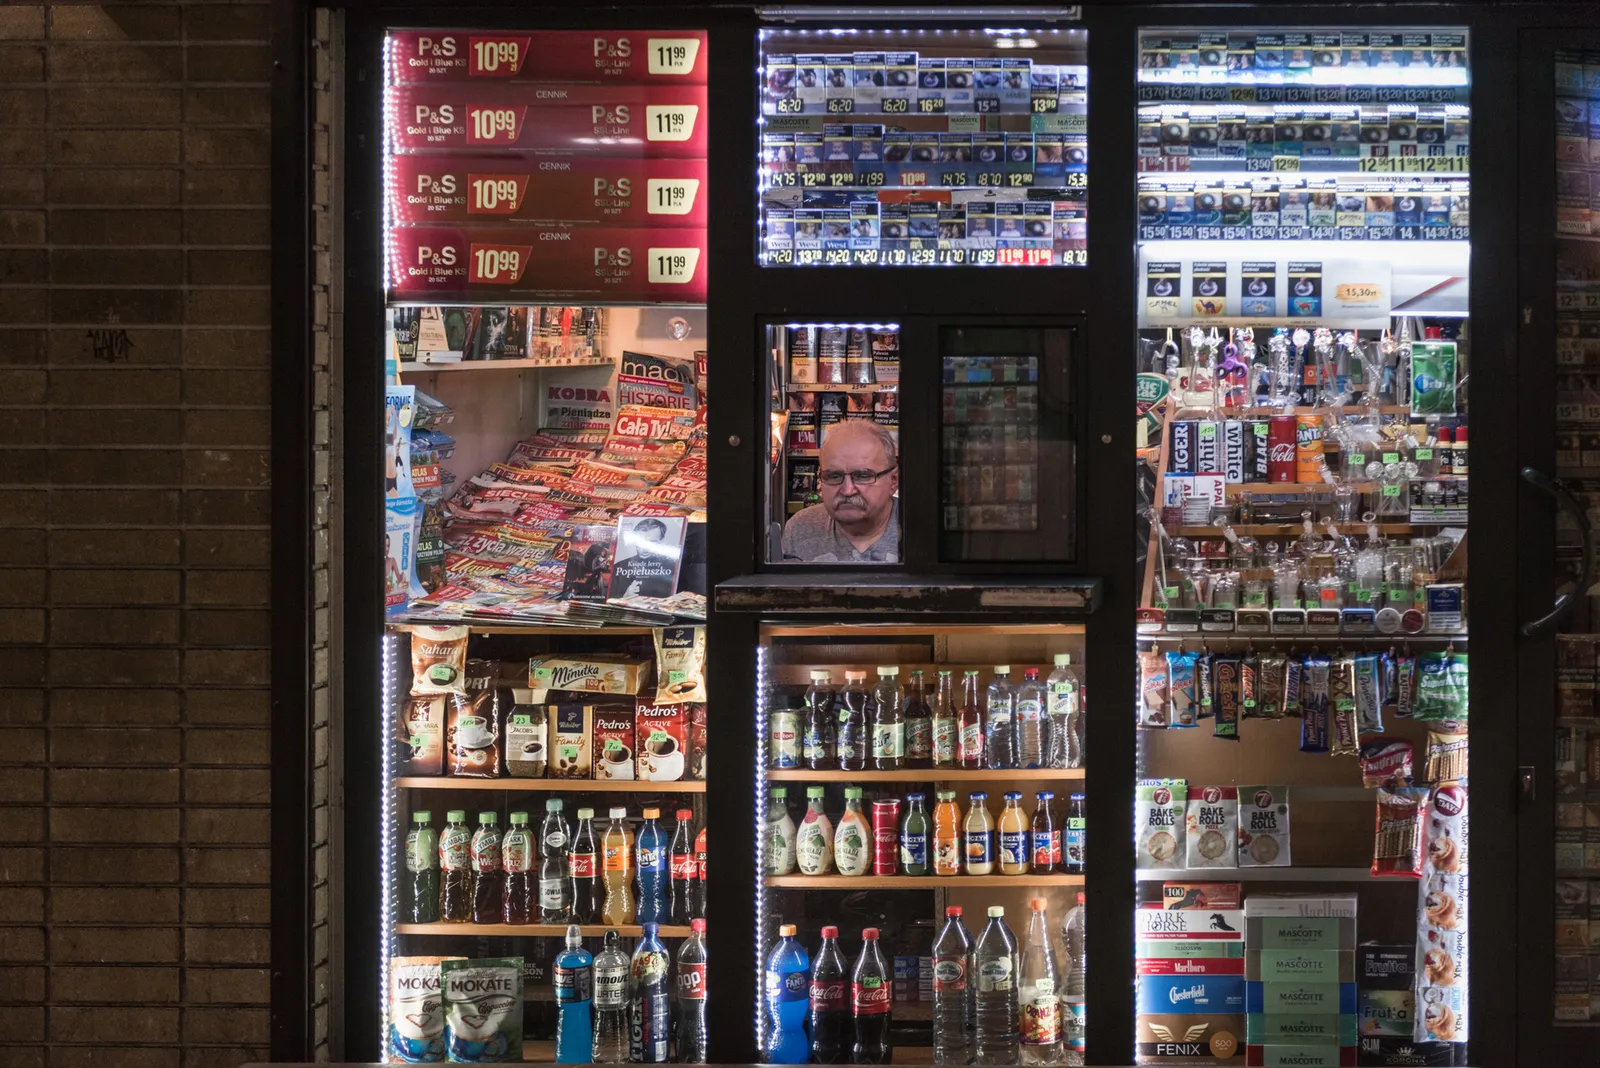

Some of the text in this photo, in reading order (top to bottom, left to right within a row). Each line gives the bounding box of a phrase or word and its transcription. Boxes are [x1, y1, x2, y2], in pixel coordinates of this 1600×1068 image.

[419, 37, 457, 56] P&S
[593, 38, 632, 57] P&S
[409, 58, 428, 67] Gold
[435, 58, 453, 66] Blue
[455, 58, 467, 66] KS
[536, 90, 568, 98] CENNIK
[416, 105, 454, 124] P&S
[592, 105, 631, 124] P&S
[407, 126, 427, 134] Gold
[433, 126, 452, 134] Blue
[539, 162, 571, 170] CENNIK
[417, 174, 456, 193] P&S
[593, 177, 632, 197] P&S
[407, 195, 427, 203] Gold
[434, 195, 453, 203] Blue
[454, 196, 466, 204] KS
[770, 241, 792, 249] West
[798, 241, 820, 249] West
[826, 240, 848, 249] West
[418, 246, 456, 265] P&S
[594, 247, 632, 266] P&S
[409, 267, 428, 275] Gold
[434, 267, 453, 275] Blue
[1140, 379, 1158, 389] tic
[548, 387, 610, 402] KOBRA
[1140, 388, 1157, 398] tac
[619, 391, 691, 409] HISTORIE
[561, 407, 611, 419] Pieniądze
[617, 417, 671, 440] Cała Ty!
[1297, 426, 1321, 443] FANTA
[519, 443, 590, 459] DETEKTYW
[1175, 424, 1188, 472] IGER
[1271, 443, 1295, 462] Cola
[1200, 436, 1214, 472] whit
[1257, 434, 1268, 474] BLAC
[411, 467, 428, 478] ATLAS
[484, 489, 529, 499] SIECI
[417, 541, 432, 551] ATLAS
[473, 534, 506, 553] życia
[627, 560, 662, 569] Ksiądz Jerzy
[616, 567, 672, 578] Popiełuszko
[419, 643, 459, 656] Sahara
[664, 651, 686, 660] Family
[552, 664, 599, 687] Minutka
[464, 677, 491, 689] ORT
[586, 679, 599, 687] 100
[637, 705, 678, 717] Pedro's
[515, 717, 526, 725] 23
[597, 718, 631, 730] Pedro's
[510, 726, 533, 734] JACOBS
[555, 735, 586, 750] Family
[1200, 807, 1224, 816] BAKE
[1438, 799, 1460, 814] DAYS
[1150, 808, 1173, 817] BAKE
[1251, 811, 1275, 820] BAKE
[1149, 816, 1175, 826] ROLLS
[1199, 815, 1225, 825] ROLLS
[1250, 820, 1277, 829] ROLLS
[1167, 887, 1184, 897] 100
[1174, 960, 1206, 972] Marlboro
[1276, 961, 1323, 969] MASCOTTE
[398, 977, 440, 990] MOKA
[451, 978, 512, 992] MOKATE
[785, 977, 805, 988] FANTA
[597, 988, 626, 997] WATER
[1169, 984, 1205, 1004] Chesterfield
[1279, 993, 1324, 1001] MASCOTTE
[631, 997, 643, 1062] TIGER
[1280, 1025, 1324, 1033] MASCOTTE
[1215, 1039, 1232, 1047] 500
[1362, 1039, 1380, 1051] SLIM
[1157, 1043, 1200, 1055] FENIX
[1279, 1057, 1324, 1065] MASCOTTE
